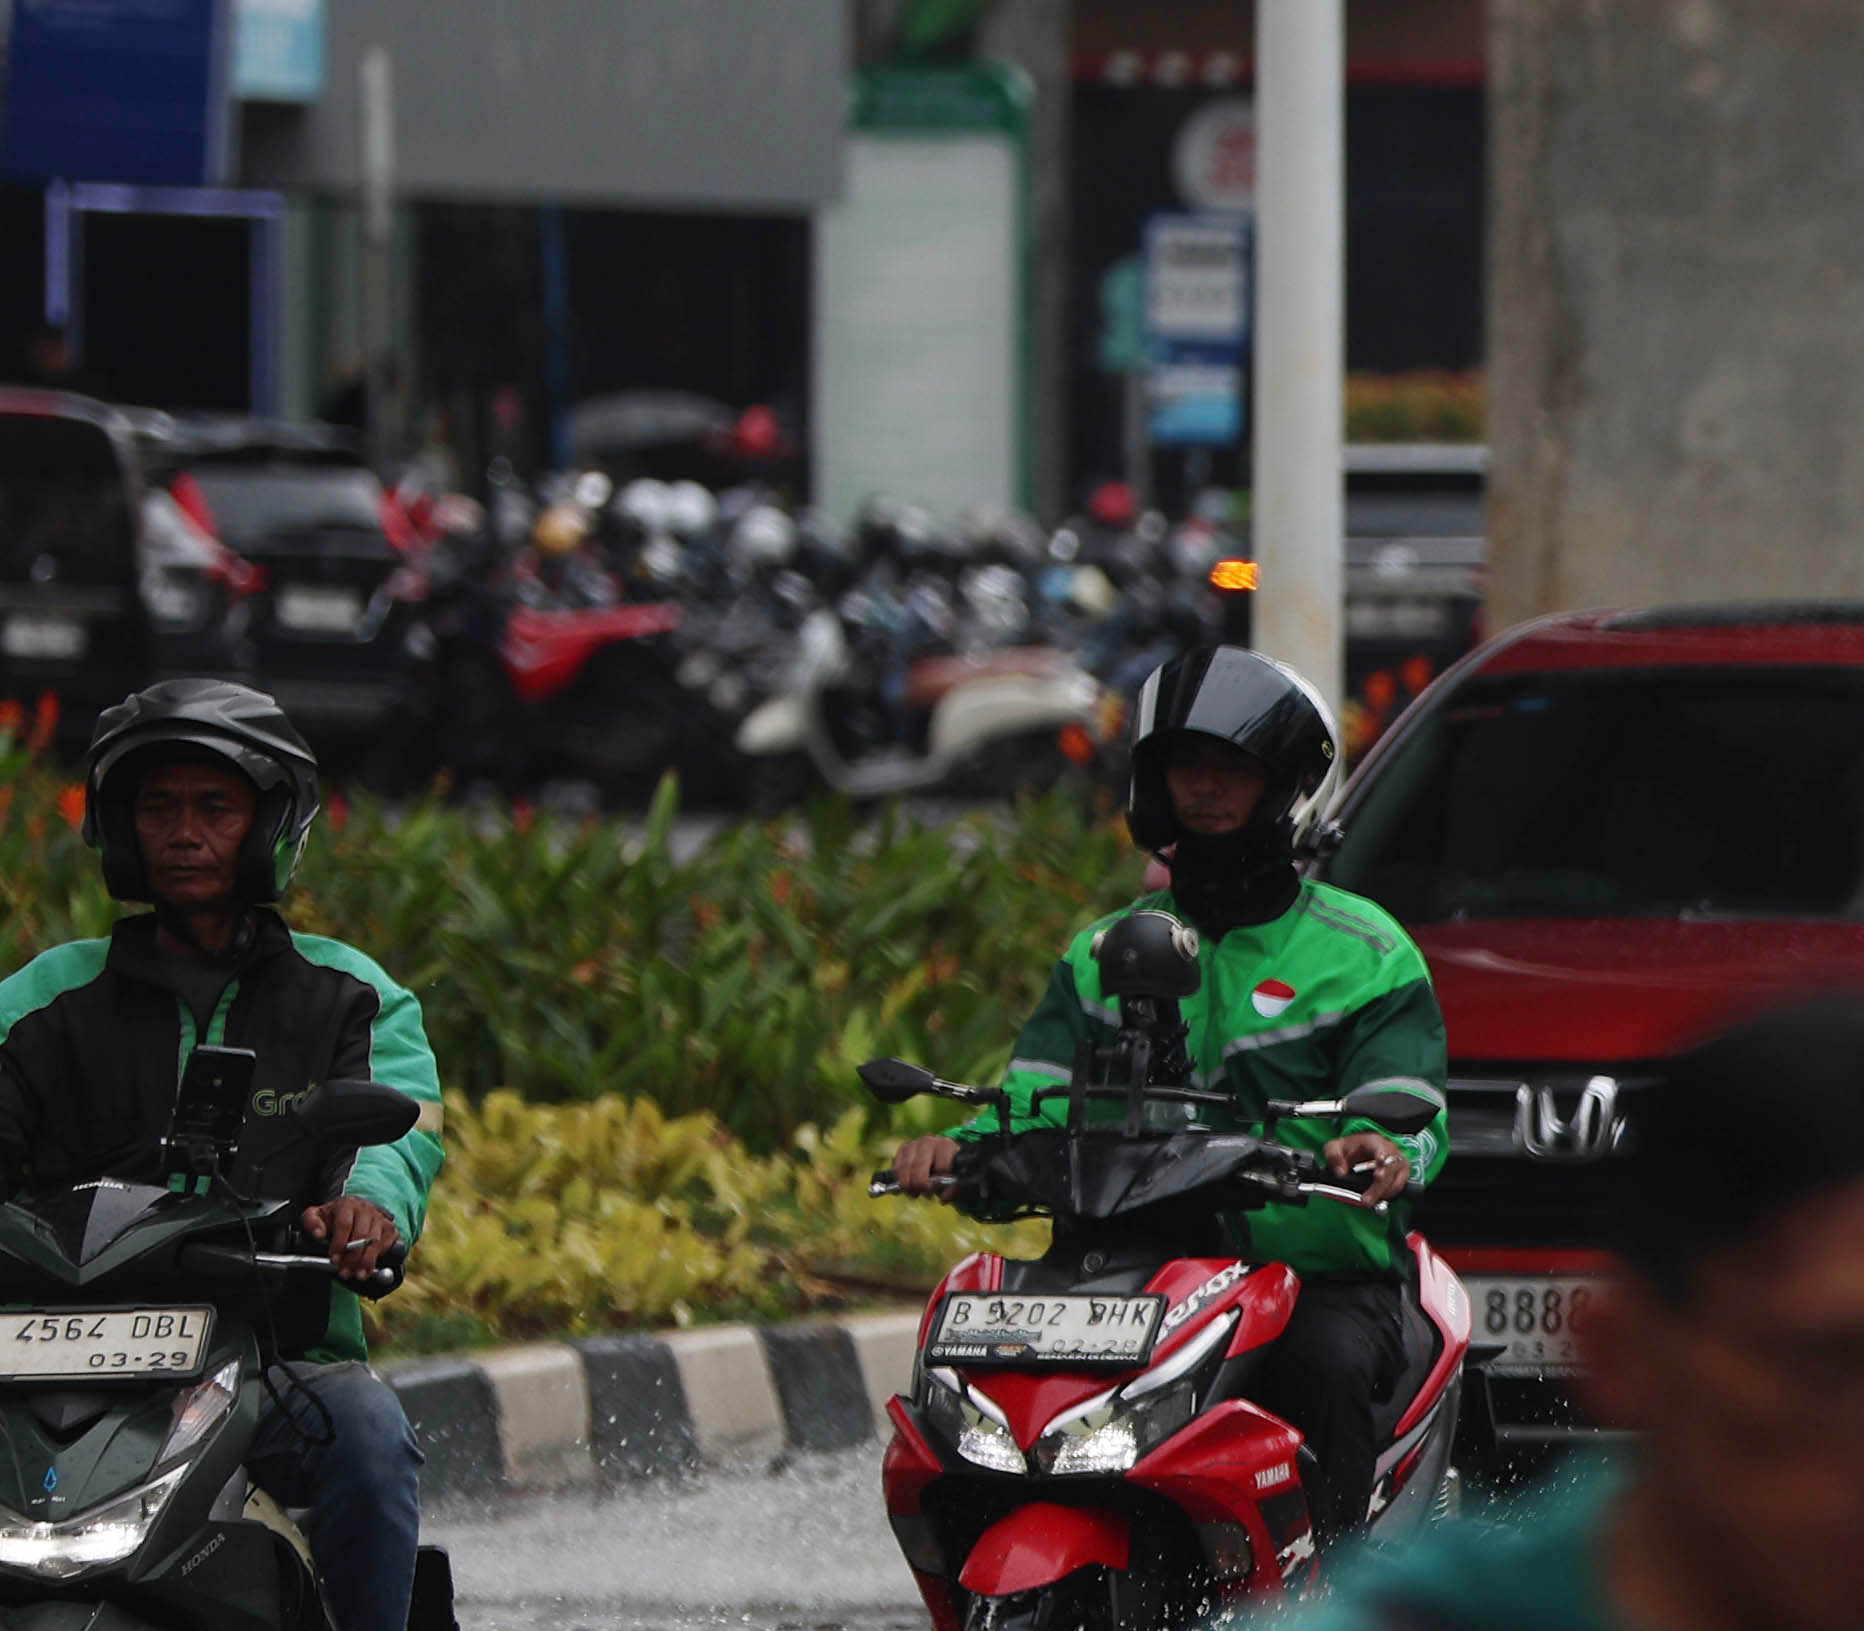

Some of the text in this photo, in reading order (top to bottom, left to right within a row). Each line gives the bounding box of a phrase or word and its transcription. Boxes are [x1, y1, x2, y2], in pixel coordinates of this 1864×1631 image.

[952, 1302, 972, 1325] B
[16, 1315, 194, 1342] 4564 DBL
[944, 1345, 988, 1356] YAMAHA
[1255, 1462, 1290, 1489] YAMAHA
[181, 1532, 226, 1577] HONDA
